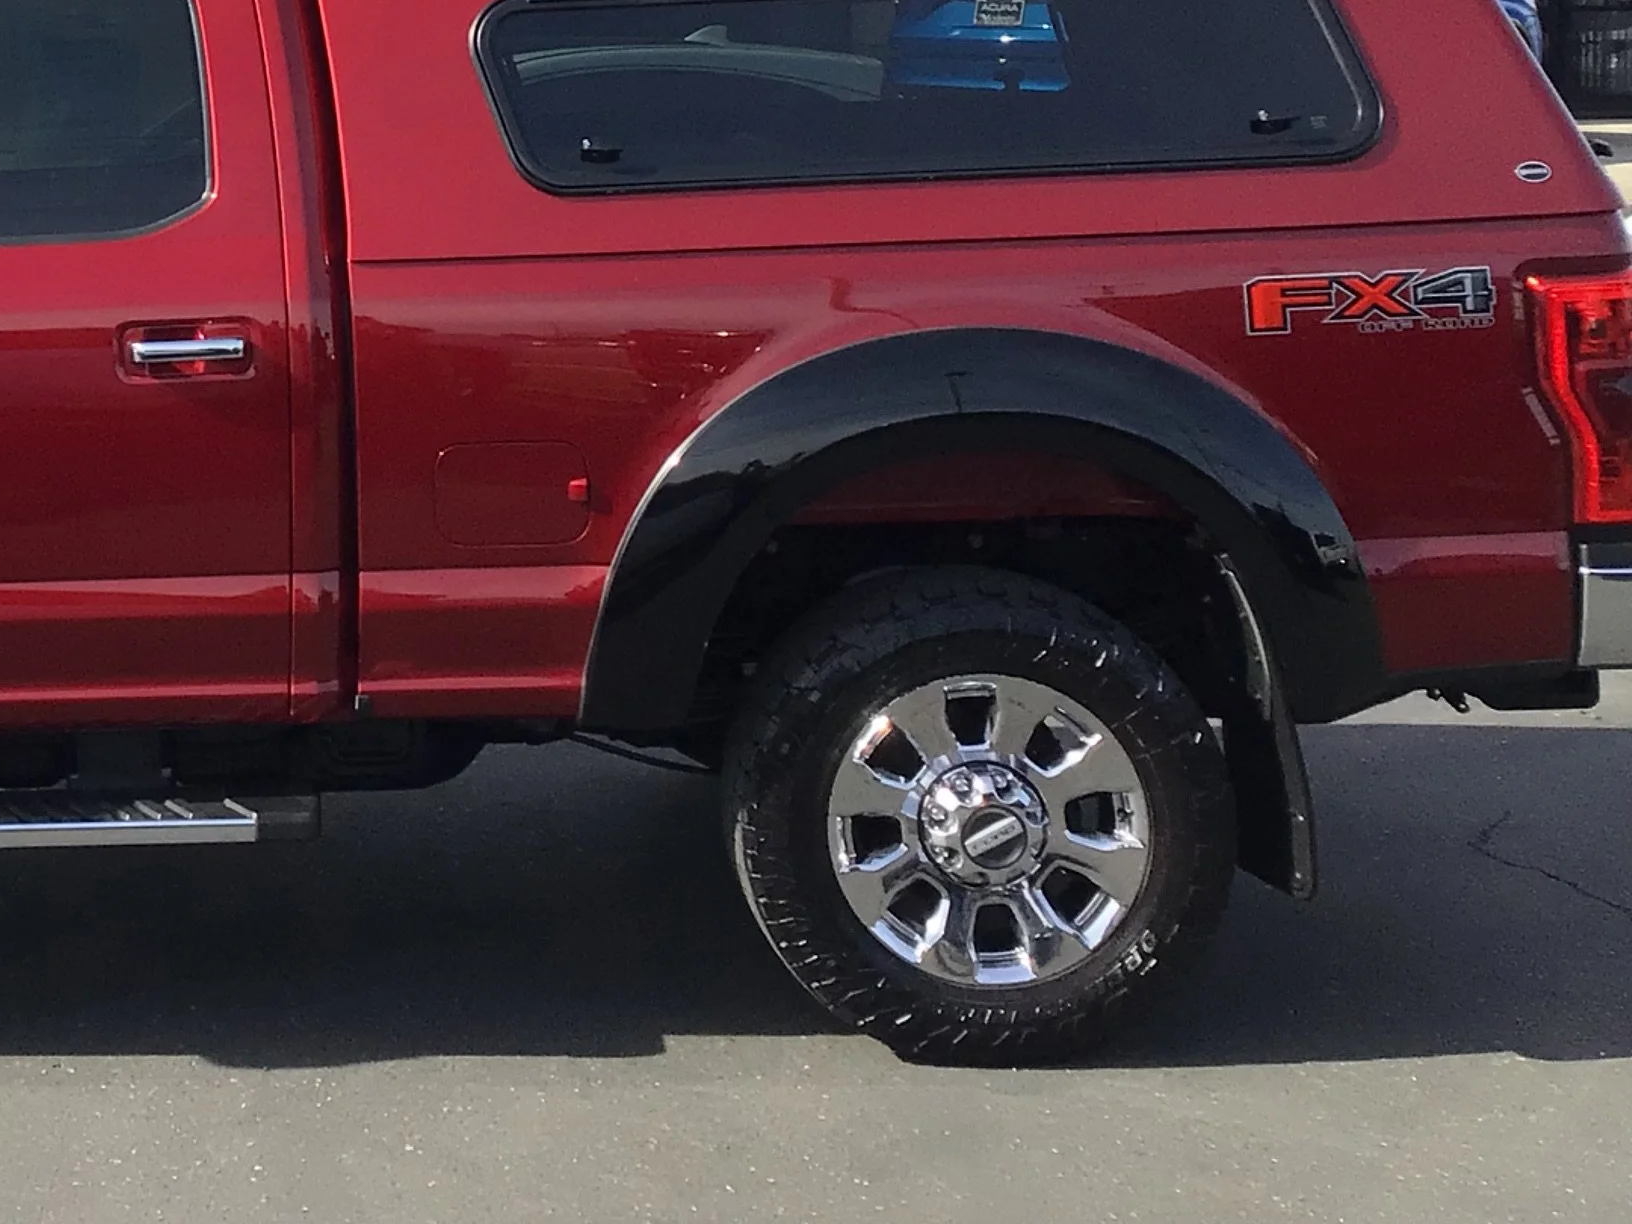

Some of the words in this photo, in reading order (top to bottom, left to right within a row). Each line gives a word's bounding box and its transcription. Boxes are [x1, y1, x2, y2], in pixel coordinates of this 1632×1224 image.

[1243, 266, 1496, 336] FX4
[1360, 321, 1413, 333] OFF
[1423, 317, 1495, 330] ROAD
